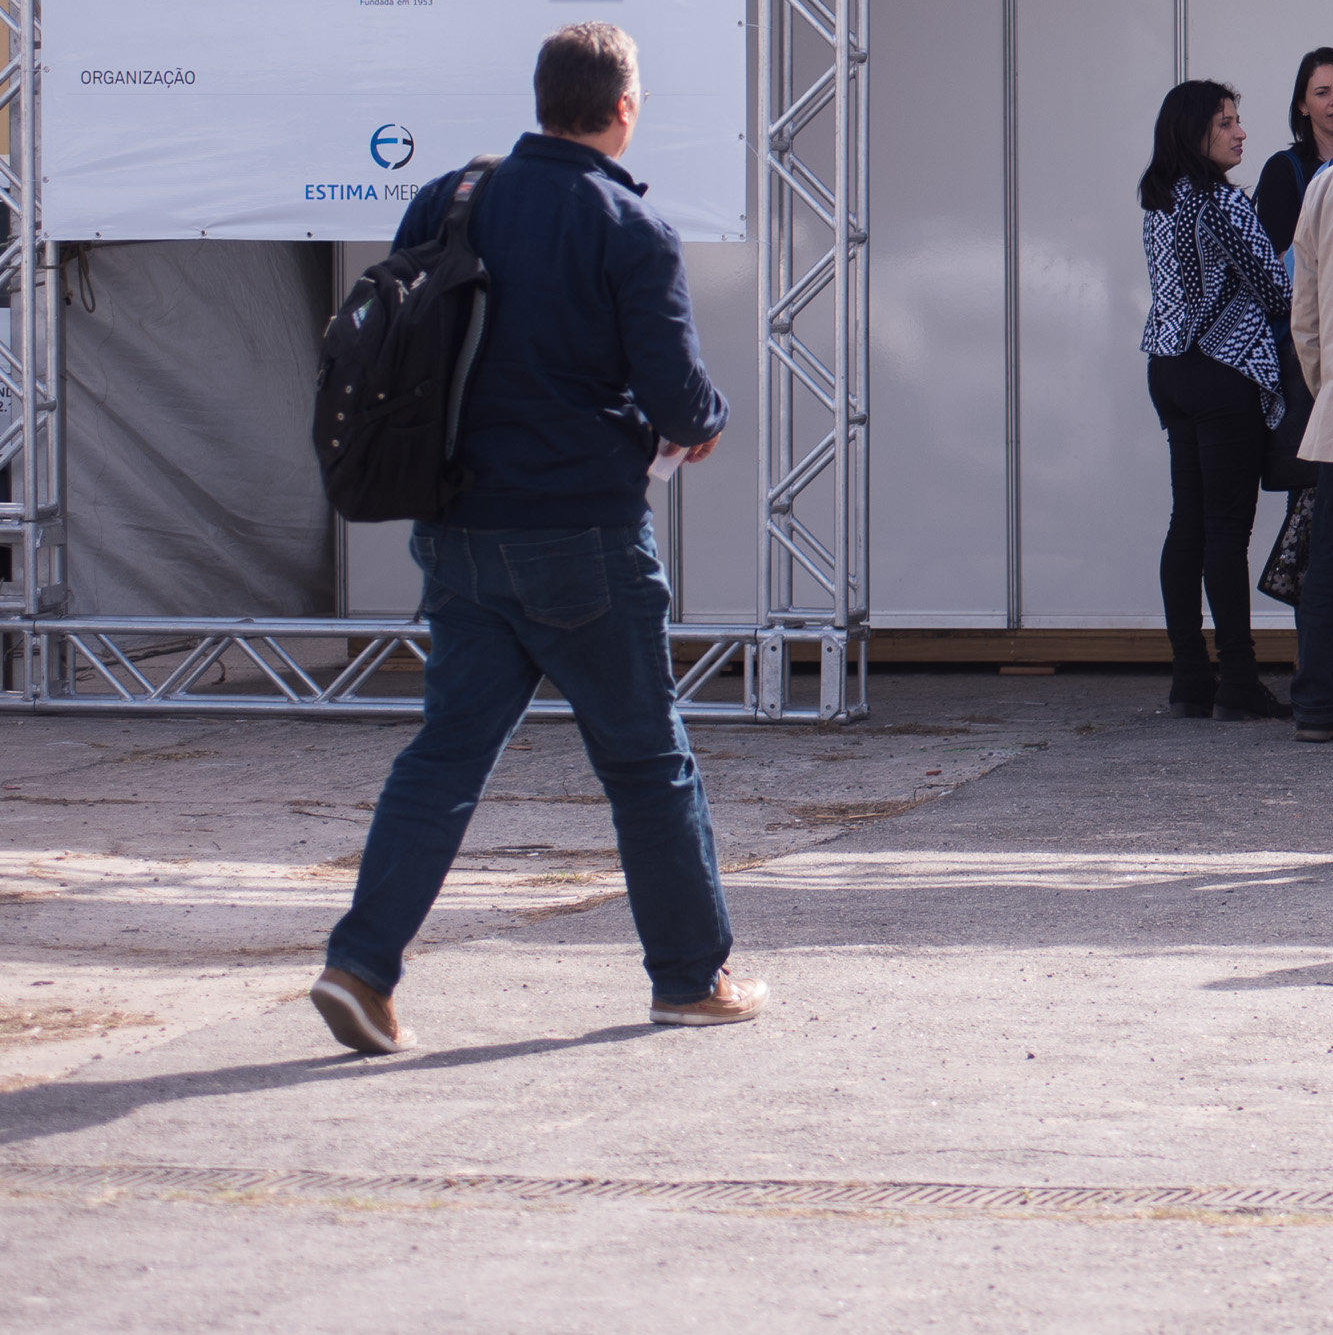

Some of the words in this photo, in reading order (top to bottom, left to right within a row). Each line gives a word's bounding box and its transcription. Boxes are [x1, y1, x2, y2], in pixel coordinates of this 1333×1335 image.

[80, 67, 196, 89] ORGANIZAÇÃO
[304, 184, 379, 201] ESTIMA
[384, 184, 419, 201] MER
